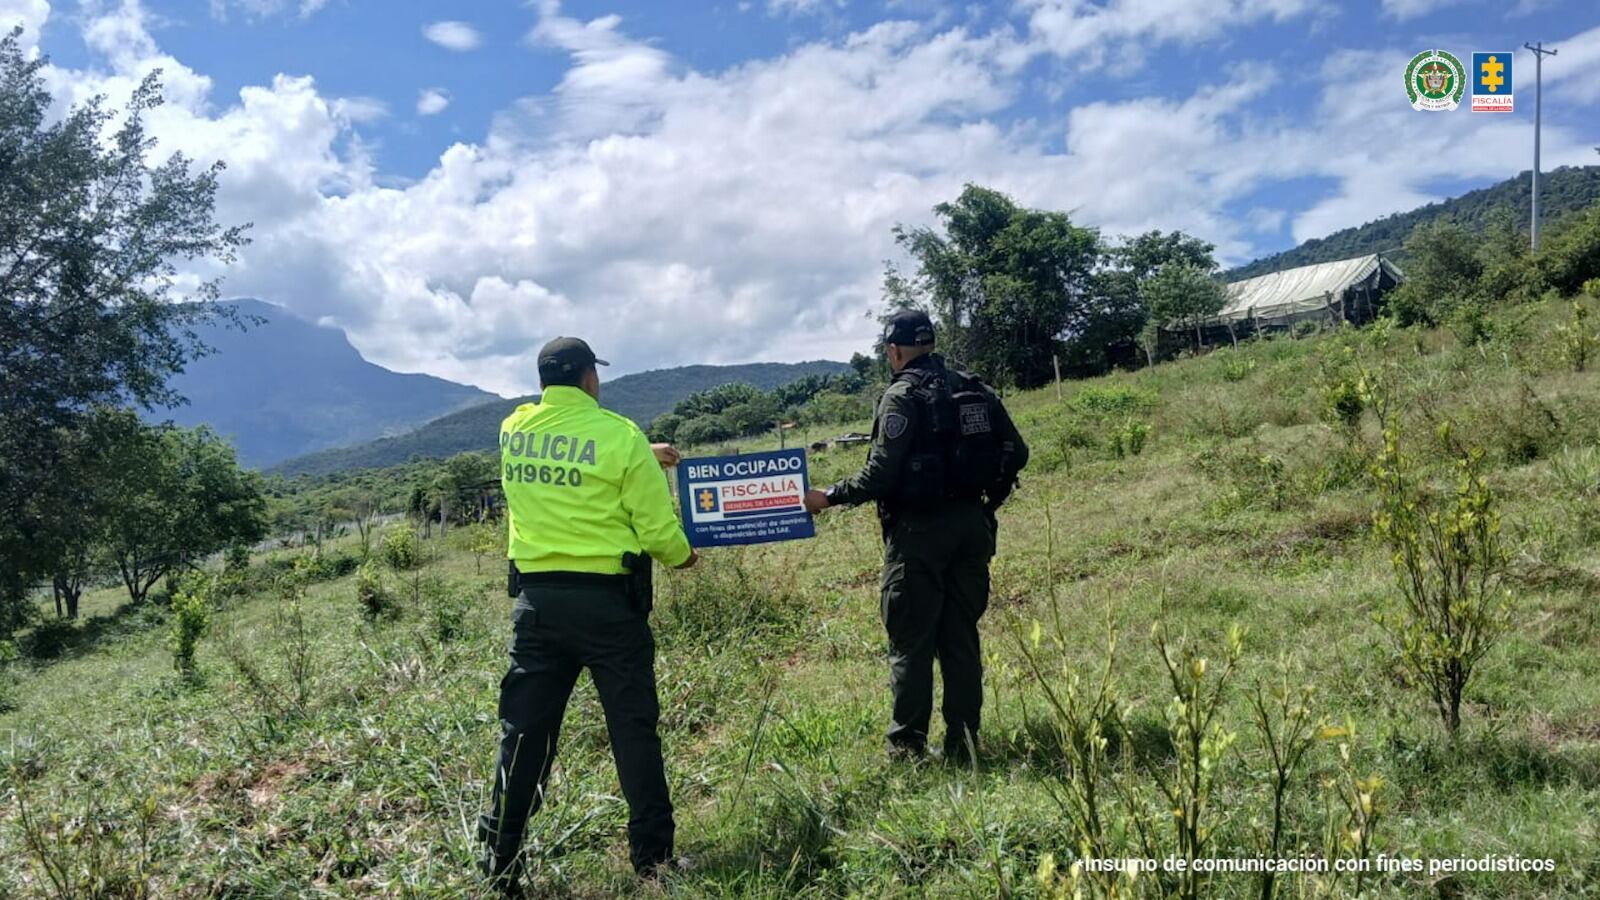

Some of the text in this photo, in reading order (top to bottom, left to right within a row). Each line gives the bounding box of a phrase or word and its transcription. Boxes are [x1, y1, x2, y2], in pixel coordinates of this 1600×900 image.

[502, 431, 595, 466] POLICIA
[505, 462, 582, 487] 919620
[688, 457, 801, 479] BIEN OCUPADO
[721, 479, 798, 497] FISCALÍA
